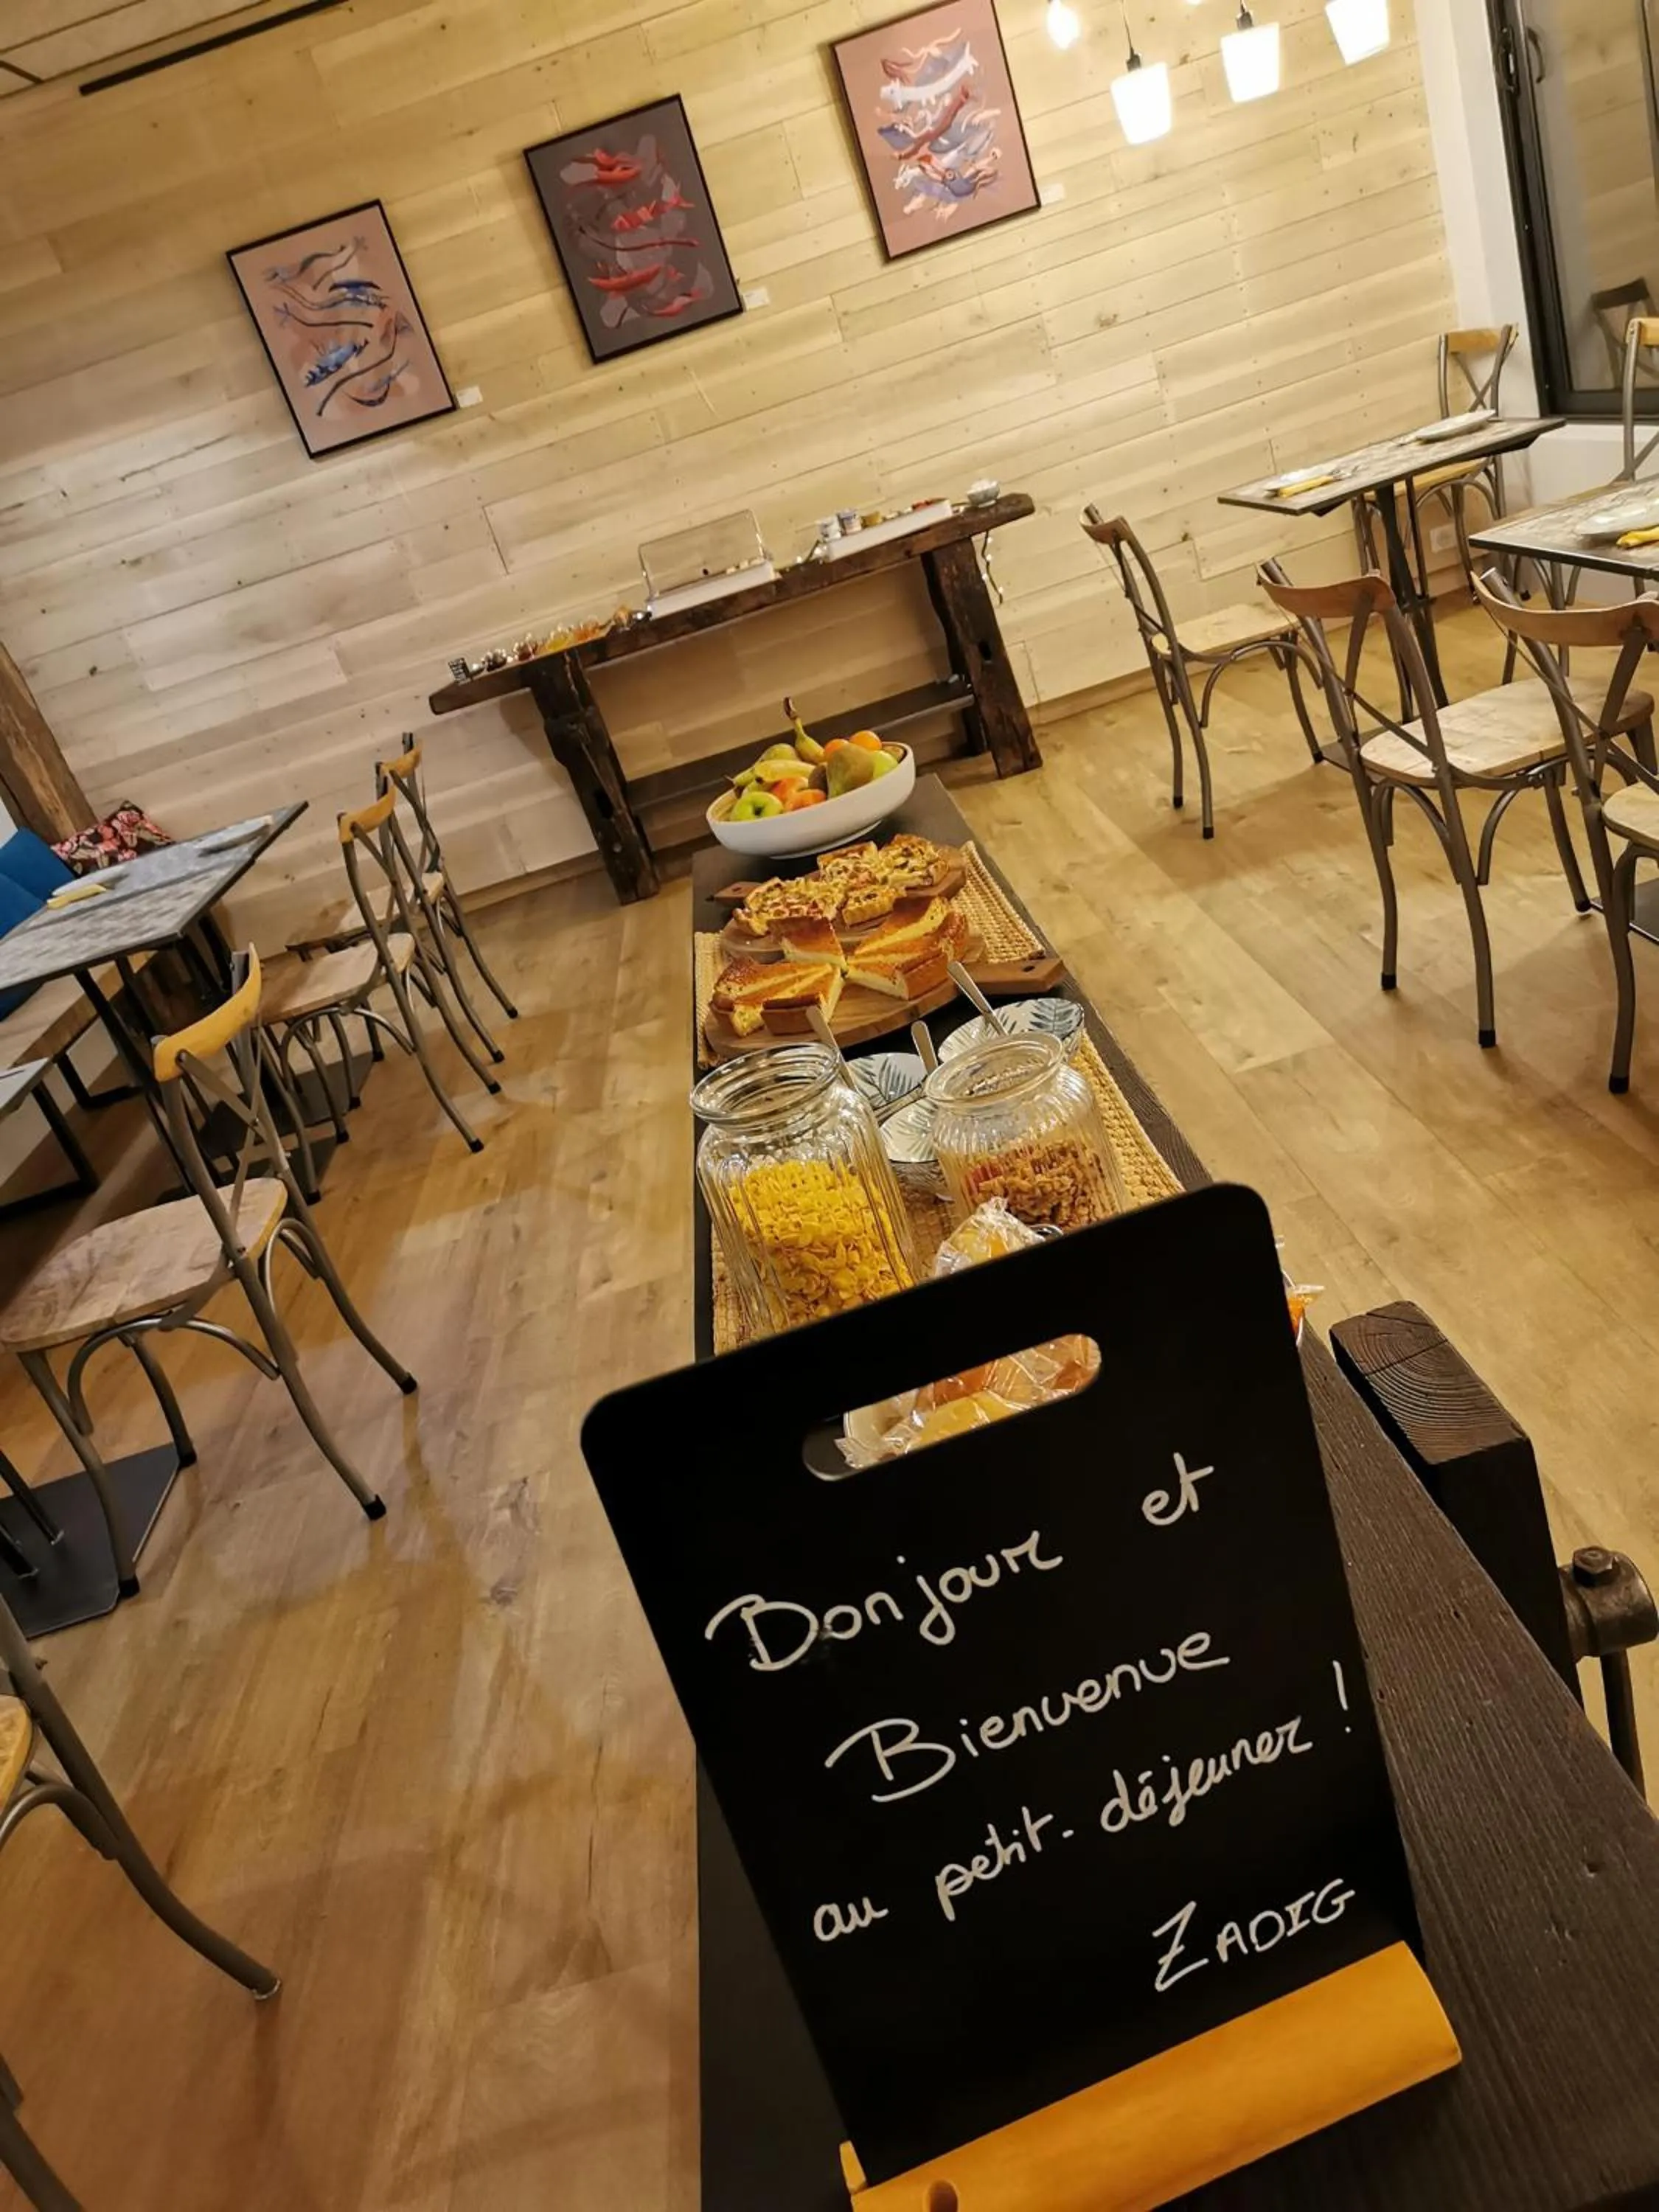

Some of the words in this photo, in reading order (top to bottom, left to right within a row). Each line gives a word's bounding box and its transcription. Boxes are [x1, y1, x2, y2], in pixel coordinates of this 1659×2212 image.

[705, 1530, 1063, 1671] Bonjour
[1142, 1452, 1214, 1526] et
[824, 1631, 1230, 1802] Bienvenue
[813, 1896, 888, 1941] au
[1152, 1877, 1355, 1992] ZADIG
